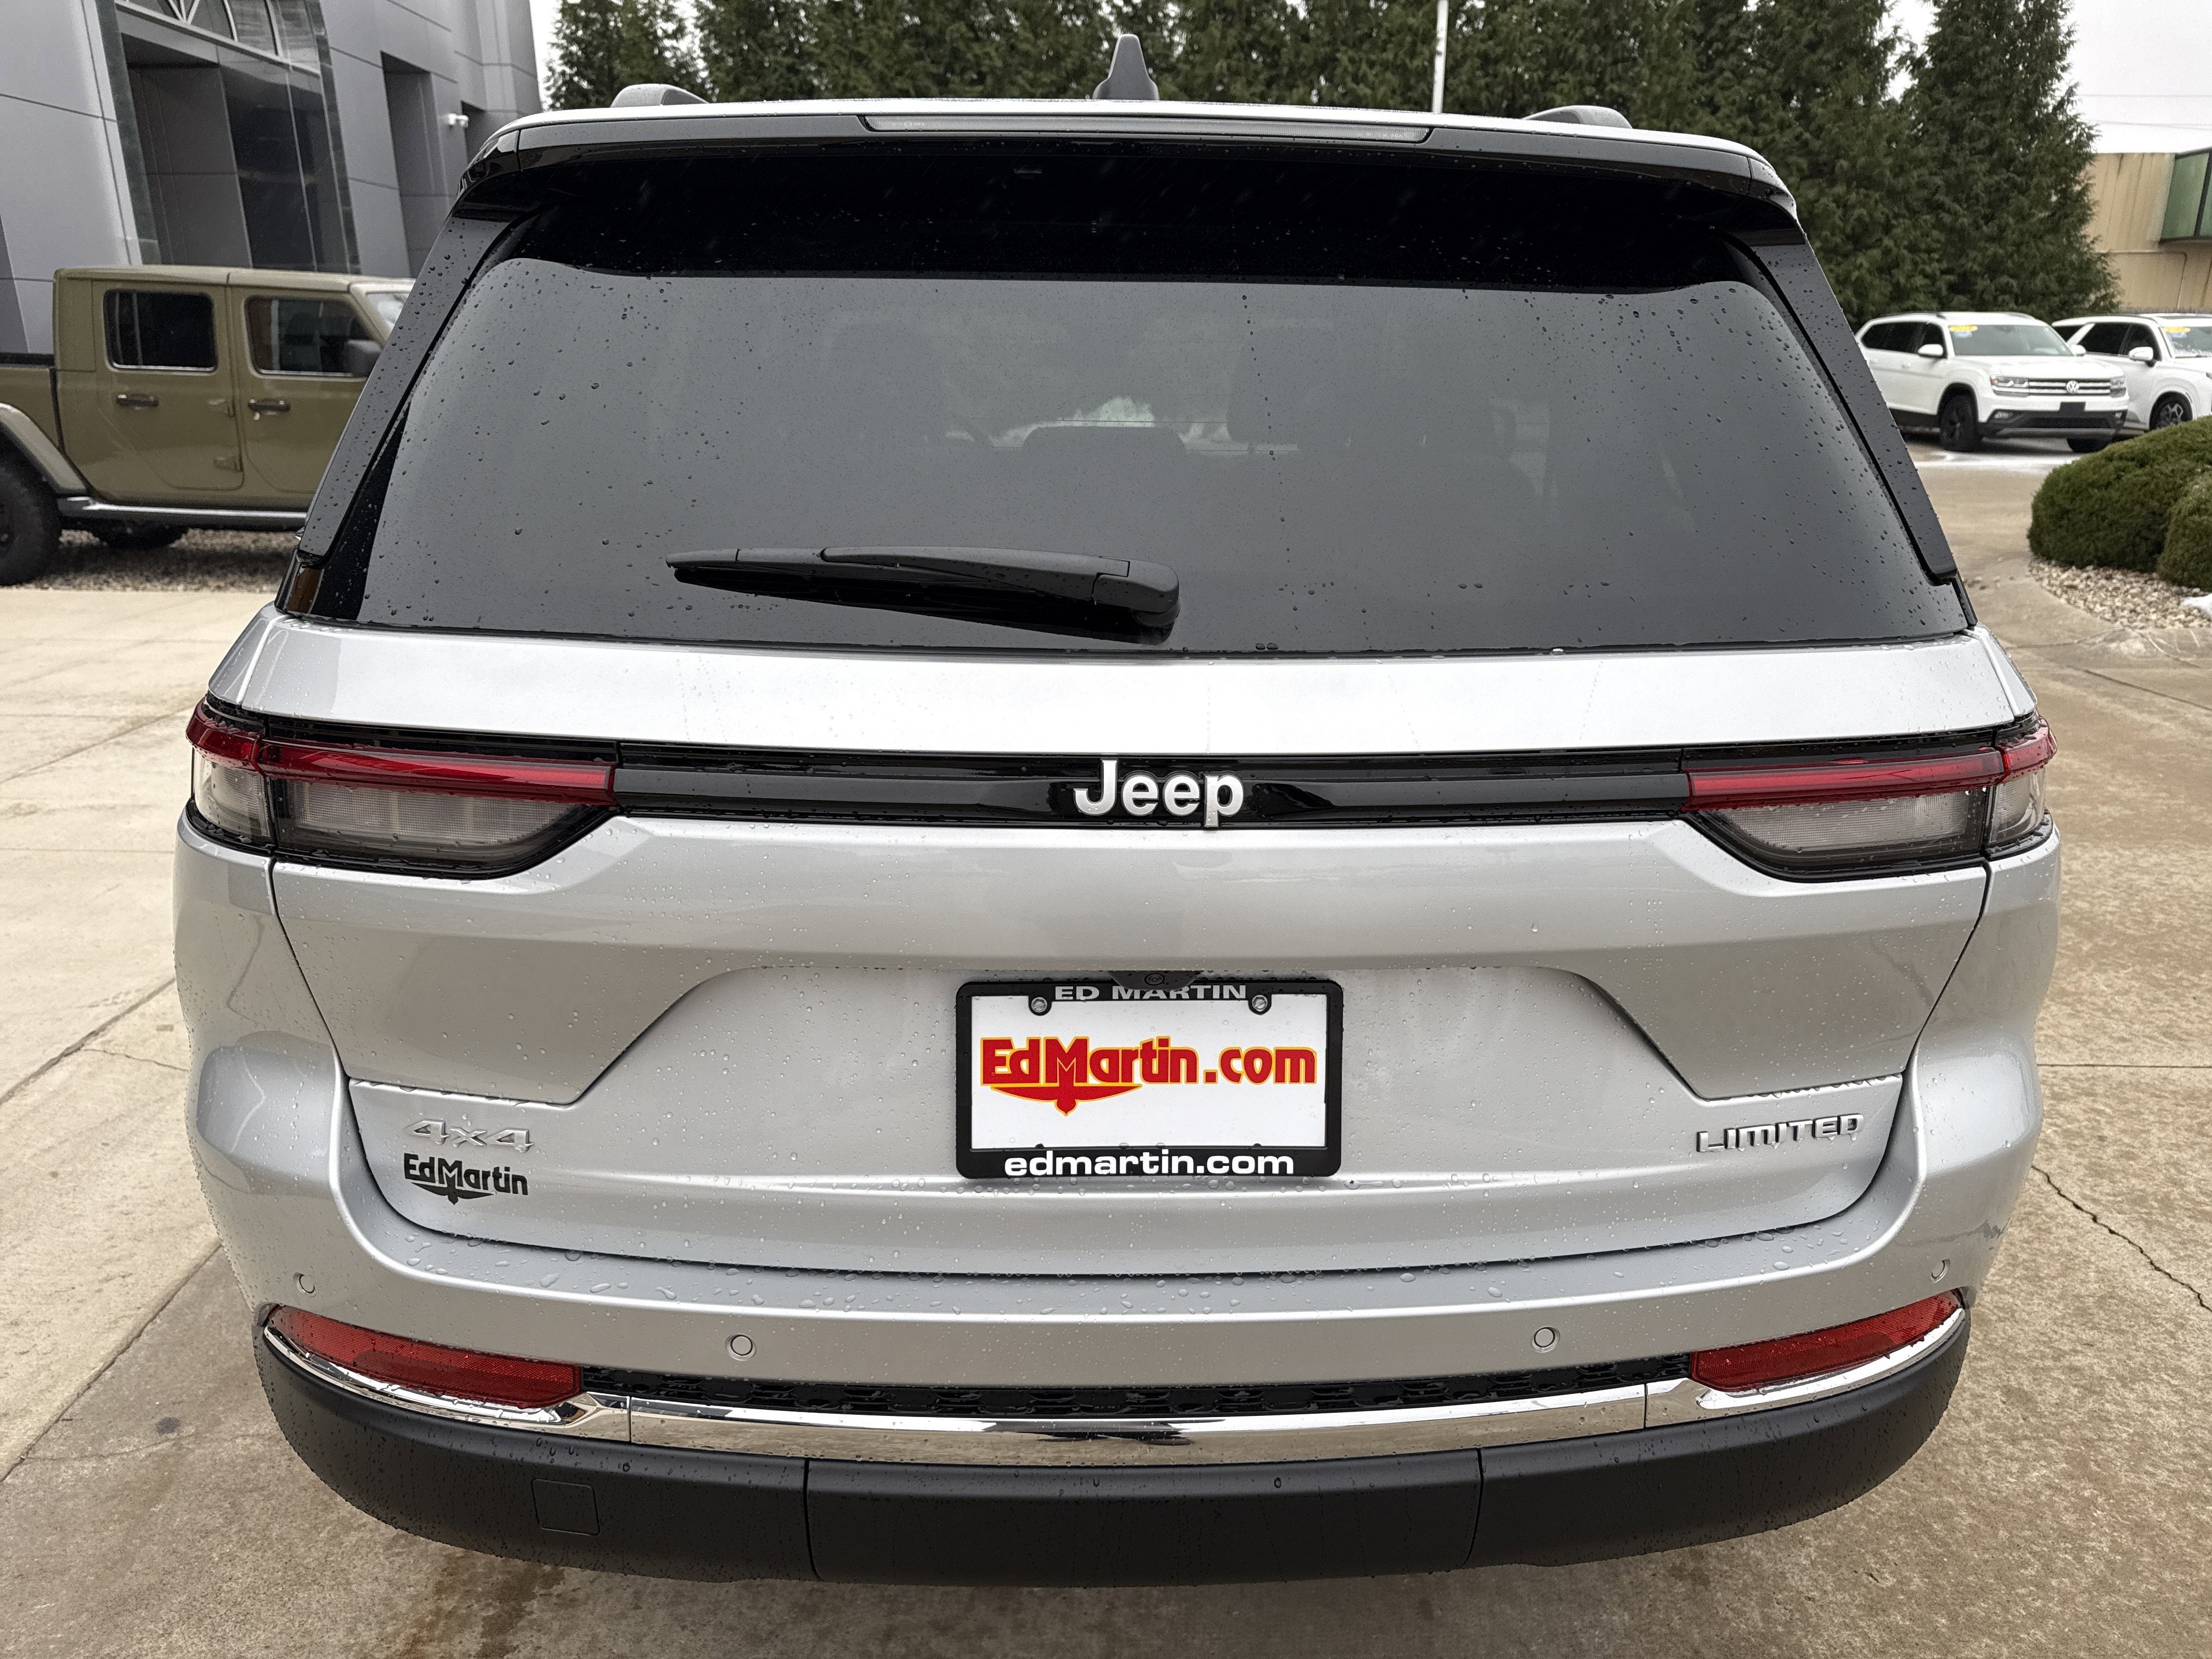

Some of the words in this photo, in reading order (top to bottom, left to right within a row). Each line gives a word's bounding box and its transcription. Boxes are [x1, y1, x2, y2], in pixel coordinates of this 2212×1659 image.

[1073, 759, 1244, 827] Jeep
[1055, 986, 1099, 1000] ED
[1112, 985, 1246, 1000] MARTIN
[980, 1036, 1317, 1086] EdMartin.com
[1696, 1113, 1864, 1152] LIMITED
[404, 1153, 528, 1195] EdMartin
[1005, 1149, 1294, 1176] edmartin.com
